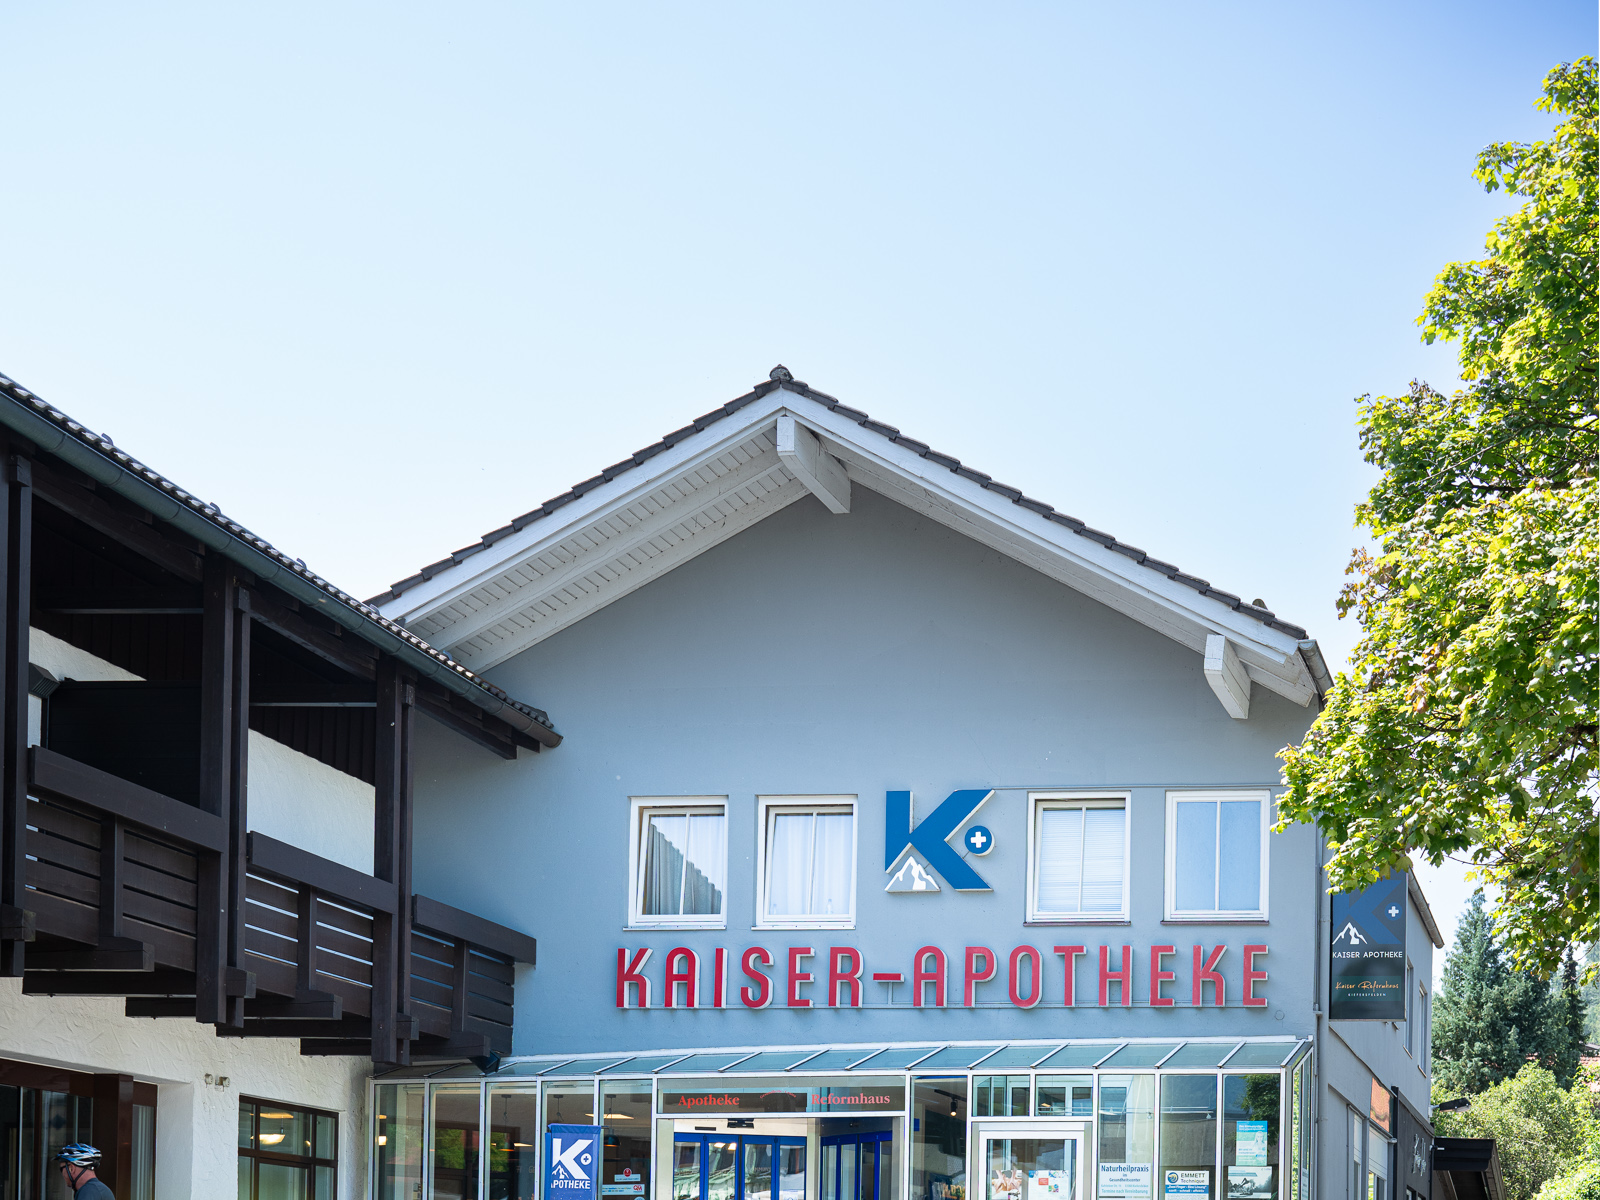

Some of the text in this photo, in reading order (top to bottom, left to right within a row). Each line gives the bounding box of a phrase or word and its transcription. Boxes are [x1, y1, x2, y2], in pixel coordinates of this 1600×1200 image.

[1332, 951, 1403, 959] KAISER APOTHEKE
[616, 945, 1268, 1009] KAISER-APOTHEKE
[678, 1093, 740, 1109] Apotheke
[811, 1092, 891, 1105] Reformhaus
[552, 1137, 594, 1180] K
[1101, 1164, 1149, 1173] Naturheilpraxis
